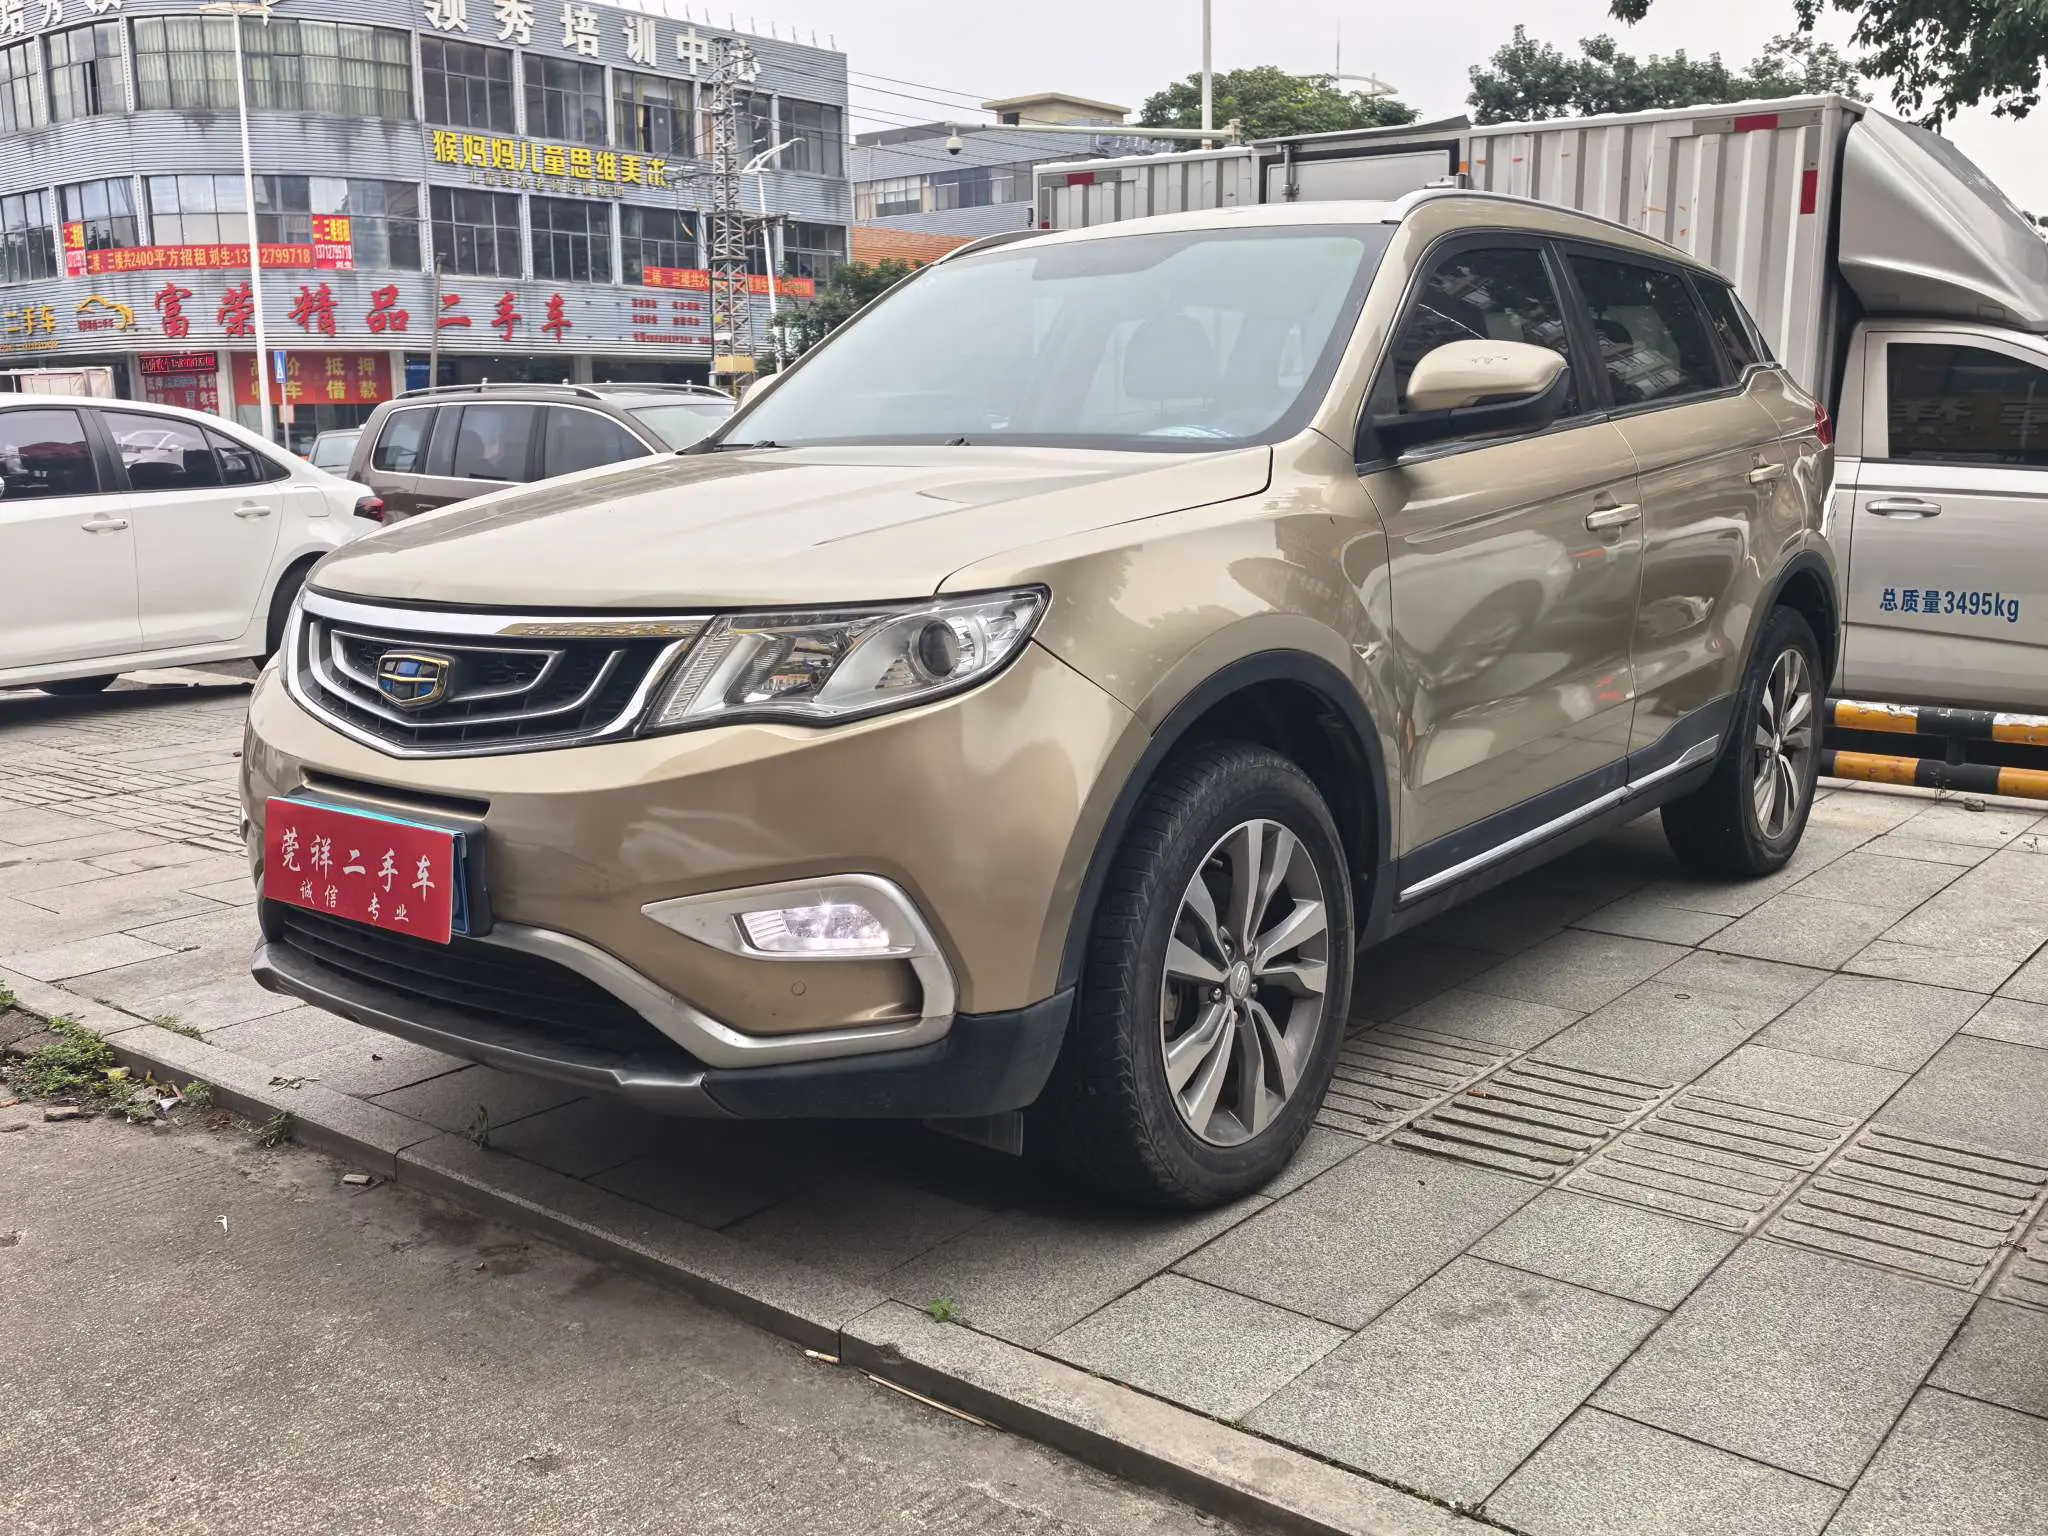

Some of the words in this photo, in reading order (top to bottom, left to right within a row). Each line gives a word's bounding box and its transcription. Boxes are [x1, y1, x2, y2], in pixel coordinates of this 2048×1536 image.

[155, 281, 573, 343] 富荣精品二手车
[325, 357, 376, 376] 抵押
[326, 379, 378, 400] 借款
[1880, 588, 2019, 623] 总质量3495kg
[281, 826, 436, 902] 莞祥二手车
[299, 879, 339, 909] 诚信
[367, 891, 410, 923] 专业
